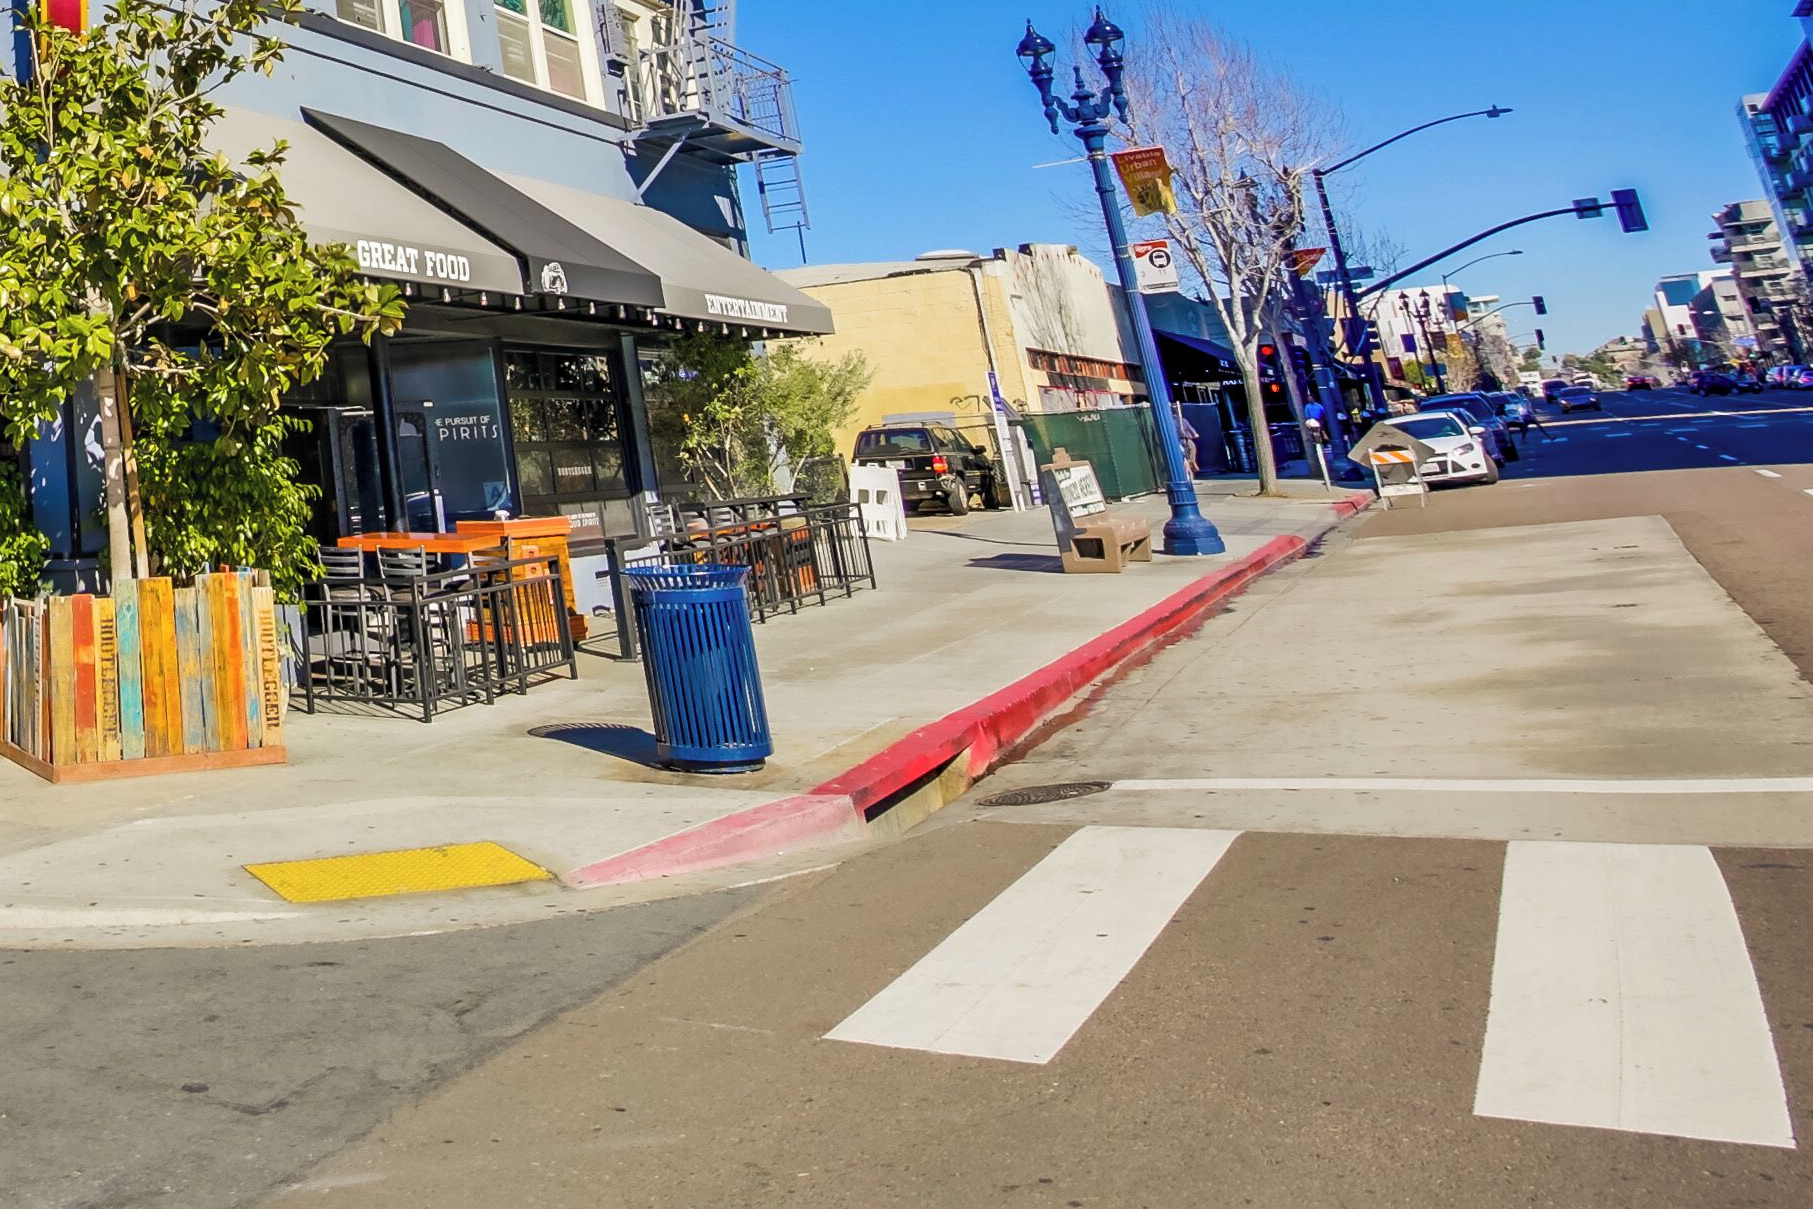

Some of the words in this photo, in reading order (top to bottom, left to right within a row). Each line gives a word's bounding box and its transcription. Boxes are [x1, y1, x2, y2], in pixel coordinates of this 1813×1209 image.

[1120, 158, 1157, 173] Urban
[356, 240, 418, 274] GREAT
[424, 251, 470, 282] FOOD
[704, 293, 788, 323] ENTERTAINMENT
[445, 416, 478, 425] PURSUIT
[480, 415, 490, 424] OF
[439, 425, 498, 441] PIRITS
[259, 609, 280, 731] BOOTLEGGER
